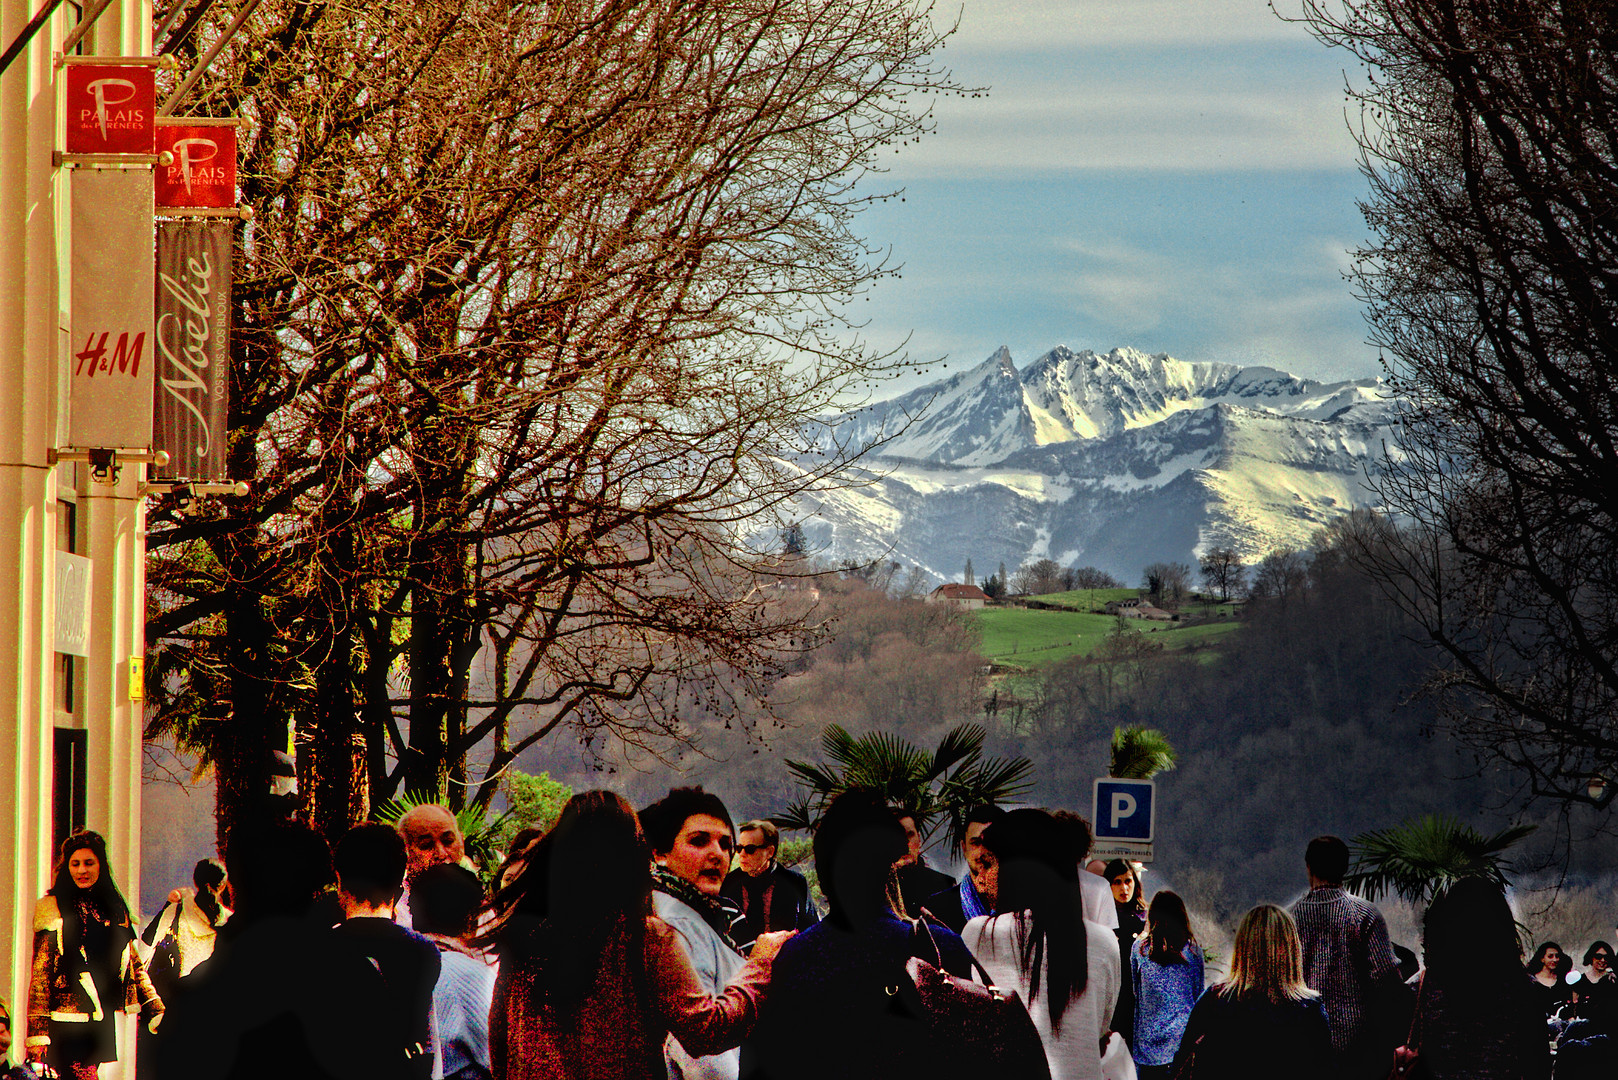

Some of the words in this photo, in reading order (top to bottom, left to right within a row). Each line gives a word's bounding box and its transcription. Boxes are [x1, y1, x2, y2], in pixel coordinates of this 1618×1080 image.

[81, 109, 144, 122] PALAIS
[167, 166, 225, 178] PALAIS
[217, 291, 226, 327] BIJOUX
[216, 330, 226, 350] VOS
[75, 331, 146, 378] H&M
[214, 380, 224, 401] VOS
[1110, 792, 1137, 829] P
